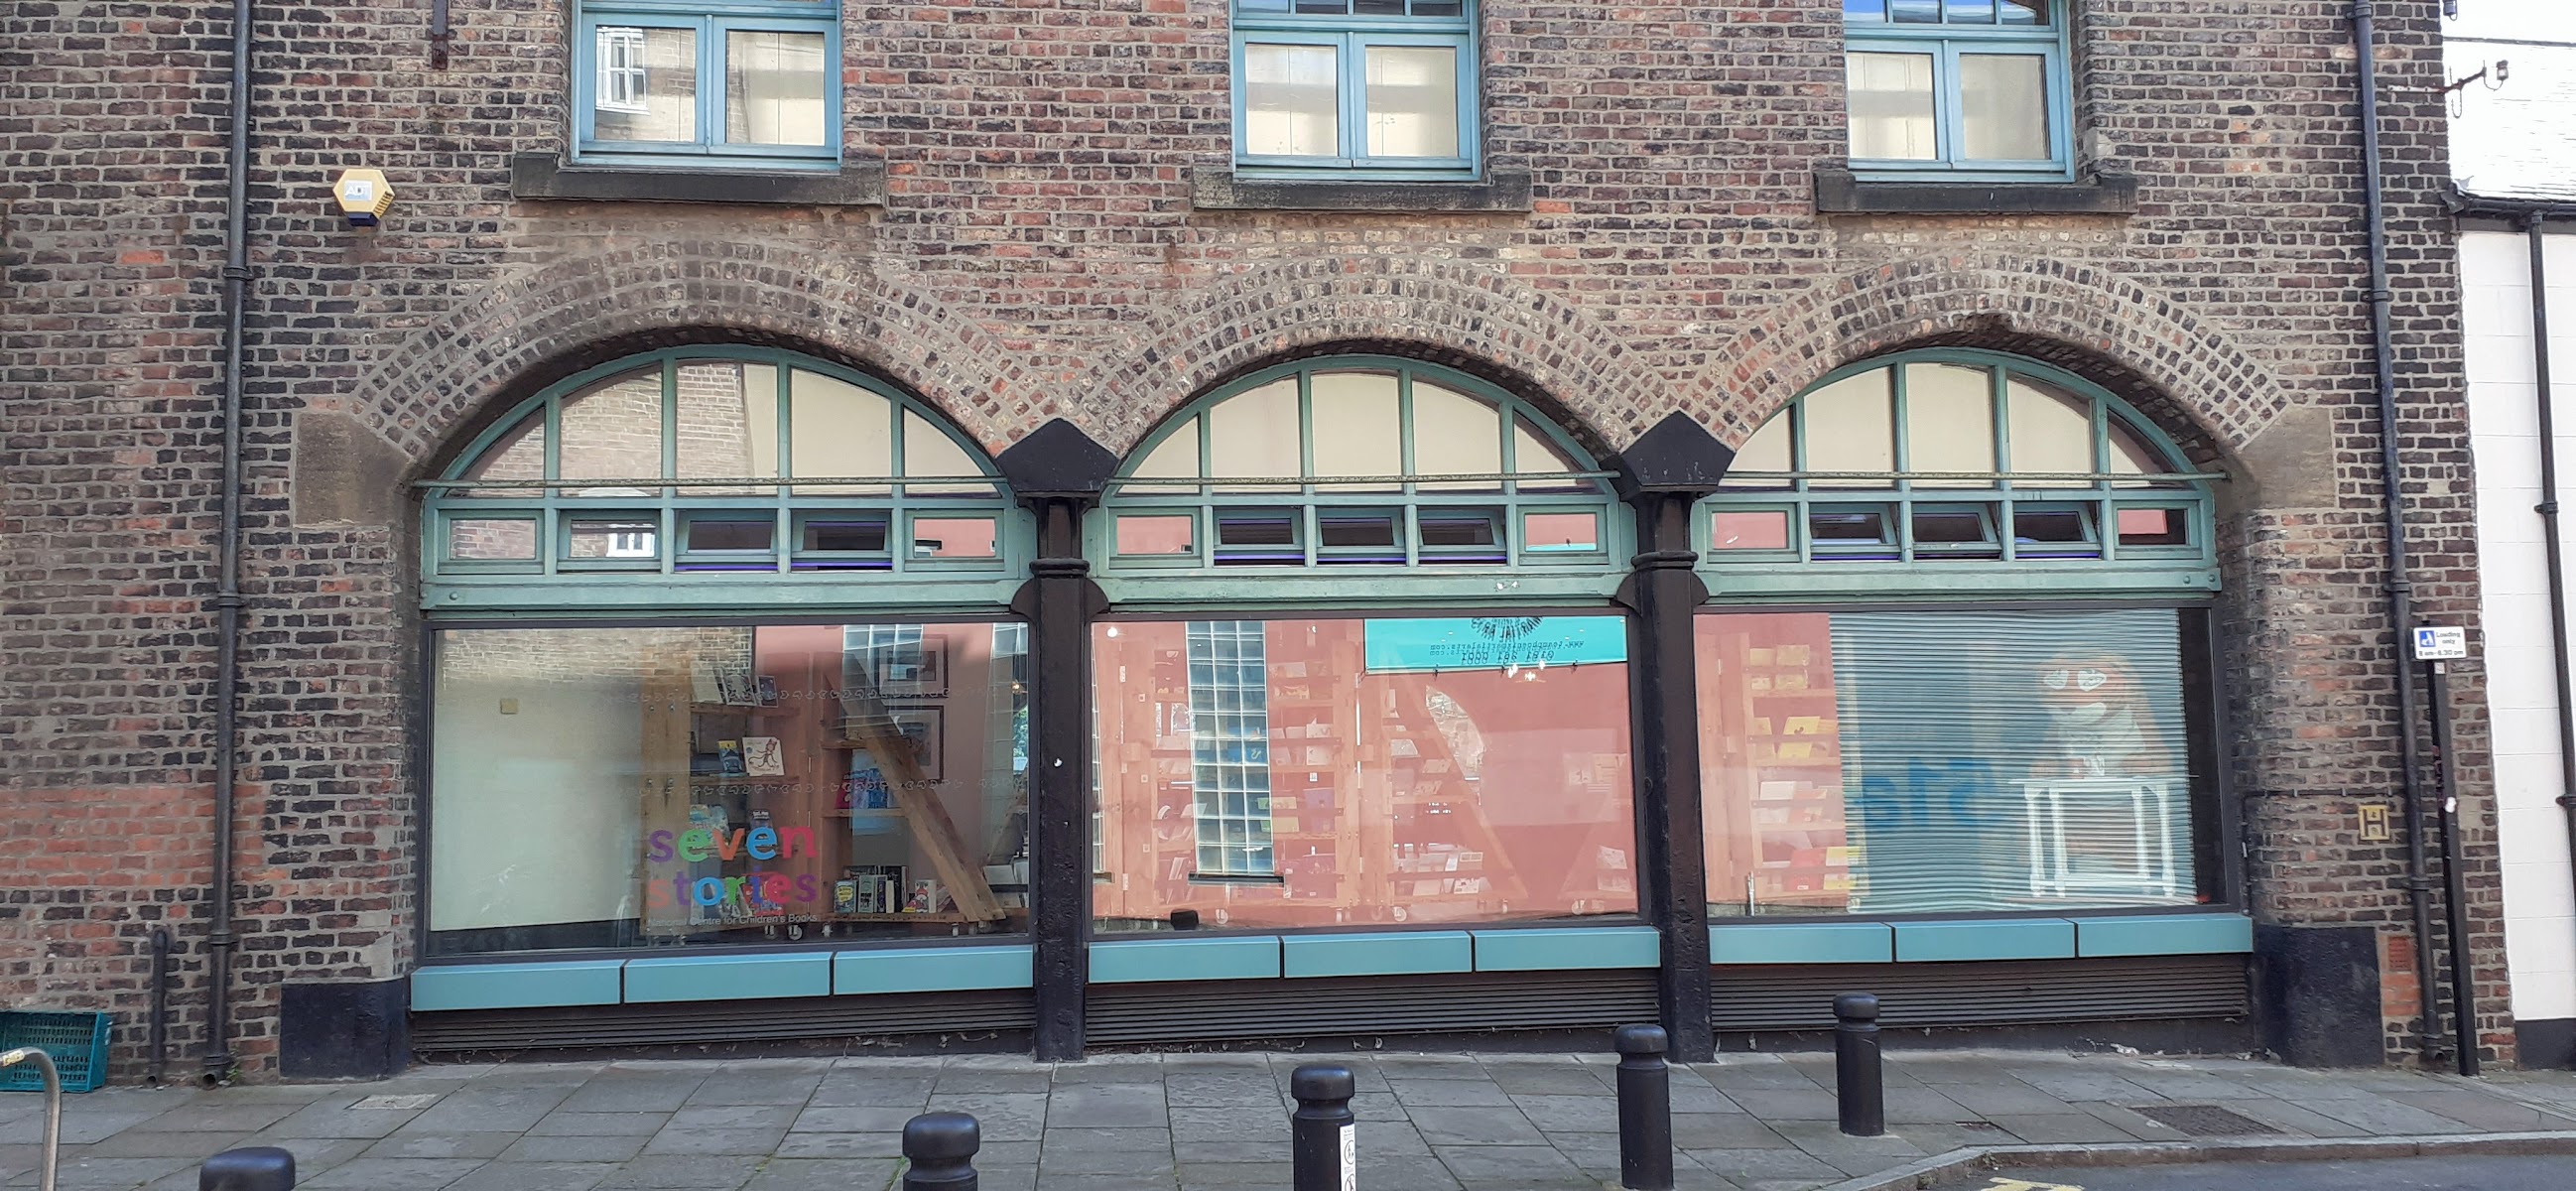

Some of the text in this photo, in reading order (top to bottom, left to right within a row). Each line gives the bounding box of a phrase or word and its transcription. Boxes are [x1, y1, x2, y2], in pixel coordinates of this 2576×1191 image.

[648, 826, 818, 862] seven
[646, 865, 818, 908] stories
[690, 916, 721, 926] Centre
[723, 916, 737, 925] for
[738, 914, 786, 925] Children's
[788, 913, 818, 923] Books
